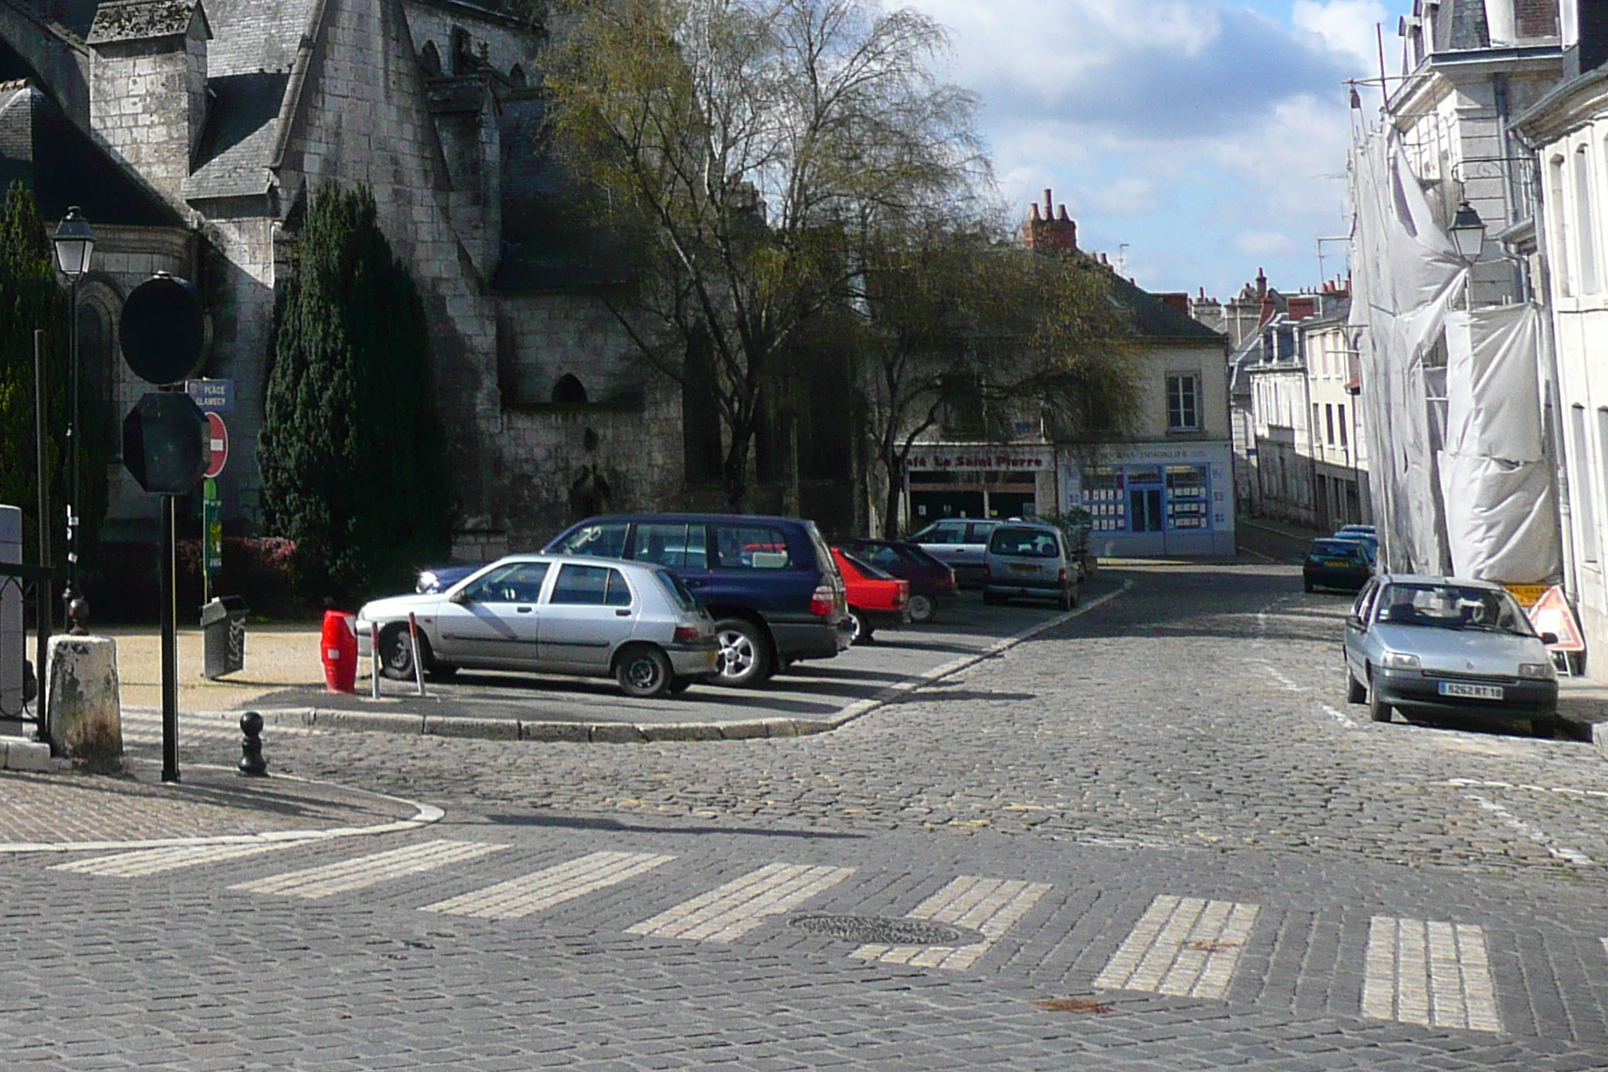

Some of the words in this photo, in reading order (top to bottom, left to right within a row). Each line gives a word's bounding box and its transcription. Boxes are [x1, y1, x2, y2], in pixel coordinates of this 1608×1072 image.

[904, 455, 927, 467] afé
[934, 456, 952, 467] Le
[996, 455, 1043, 467] Pierre
